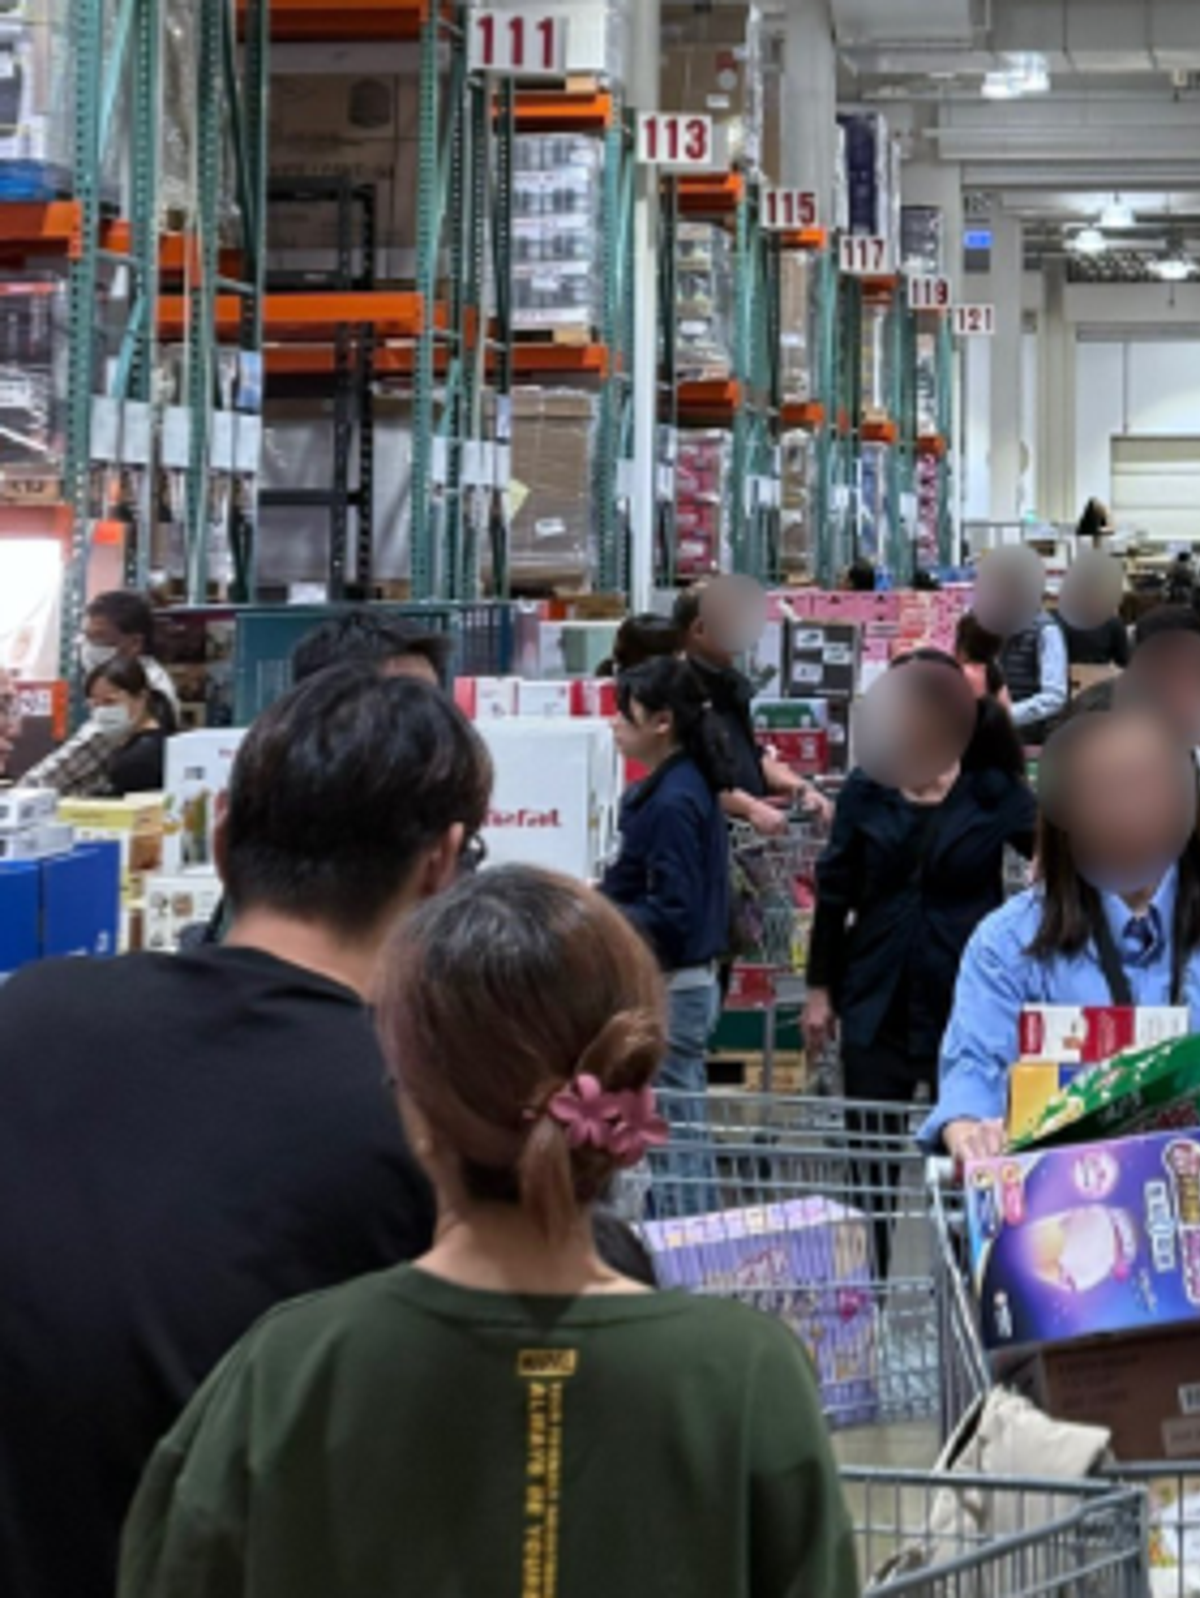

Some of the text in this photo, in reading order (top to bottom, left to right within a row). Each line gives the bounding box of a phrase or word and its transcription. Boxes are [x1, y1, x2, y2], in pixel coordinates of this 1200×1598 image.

[477, 13, 553, 69] 111
[644, 116, 707, 160] 113
[766, 192, 816, 226] 115
[844, 239, 884, 270] 117
[912, 278, 948, 305] 119
[959, 307, 992, 331] 121
